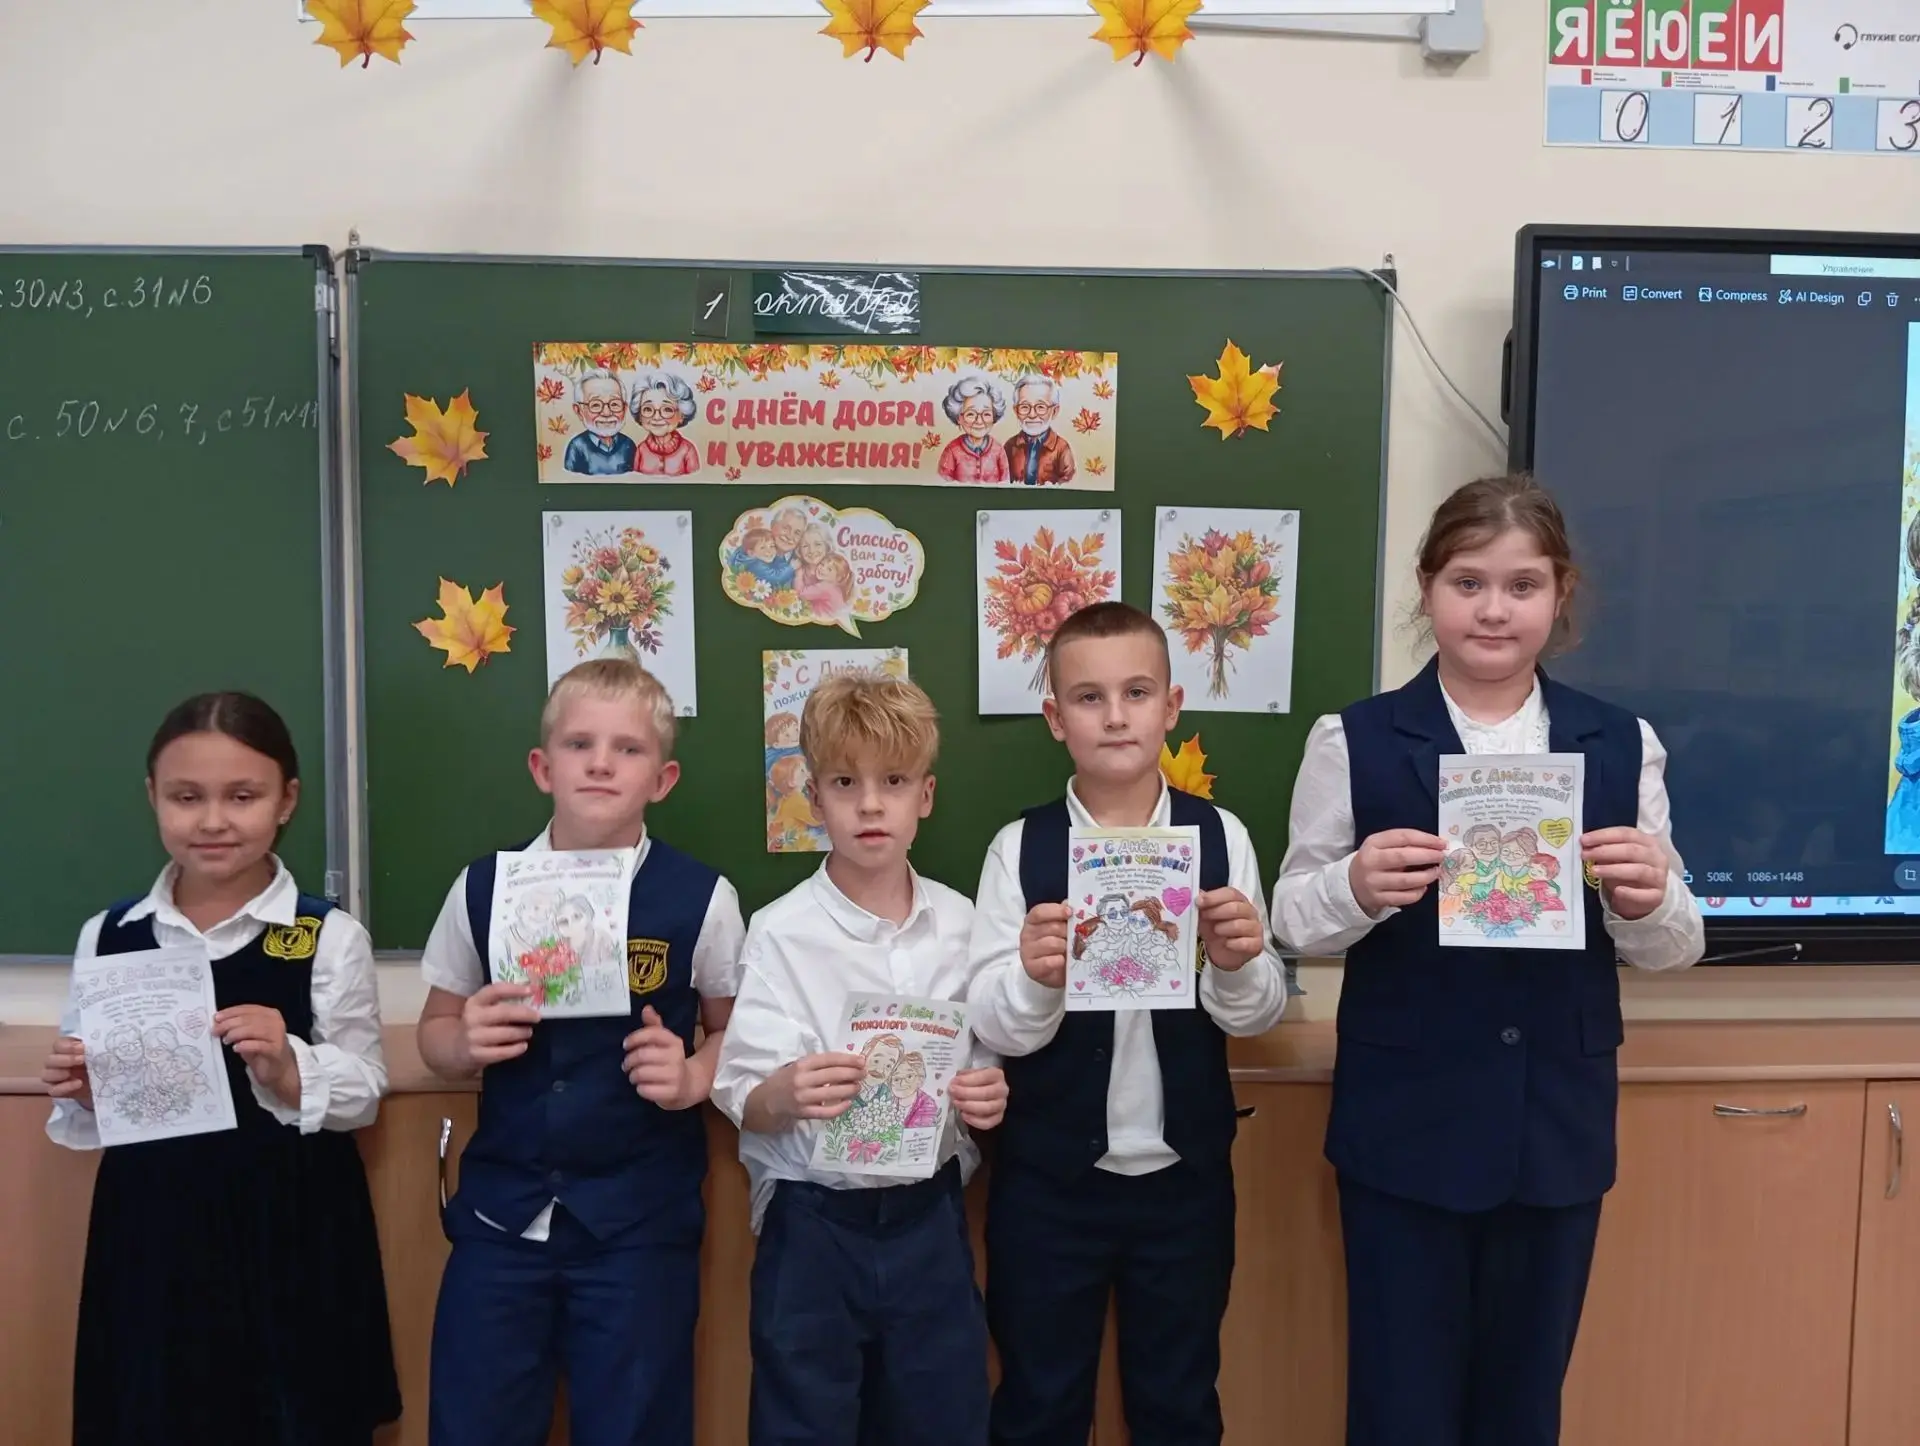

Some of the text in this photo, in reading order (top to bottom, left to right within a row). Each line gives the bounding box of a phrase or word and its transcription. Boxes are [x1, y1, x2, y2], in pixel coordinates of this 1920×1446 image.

[1860, 33, 1896, 42] ГЛУХИЕ
[1720, 94, 1742, 145] 1
[1798, 98, 1833, 148] 2
[1889, 100, 1920, 150] 3
[1822, 262, 1874, 275] Управление
[1582, 286, 1845, 305] Print Convert Compress AI Design
[704, 293, 724, 320] 1
[706, 391, 936, 430] С ДНЁМ ДОБРА
[706, 440, 923, 470] И УВАЖЕНИЯ!
[837, 527, 909, 553] Спасибо
[880, 553, 895, 564] за
[857, 564, 914, 588] заботу!
[796, 665, 810, 684] С
[1706, 872, 1733, 882] 508K
[638, 955, 651, 976] 7
[886, 1003, 898, 1016] С
